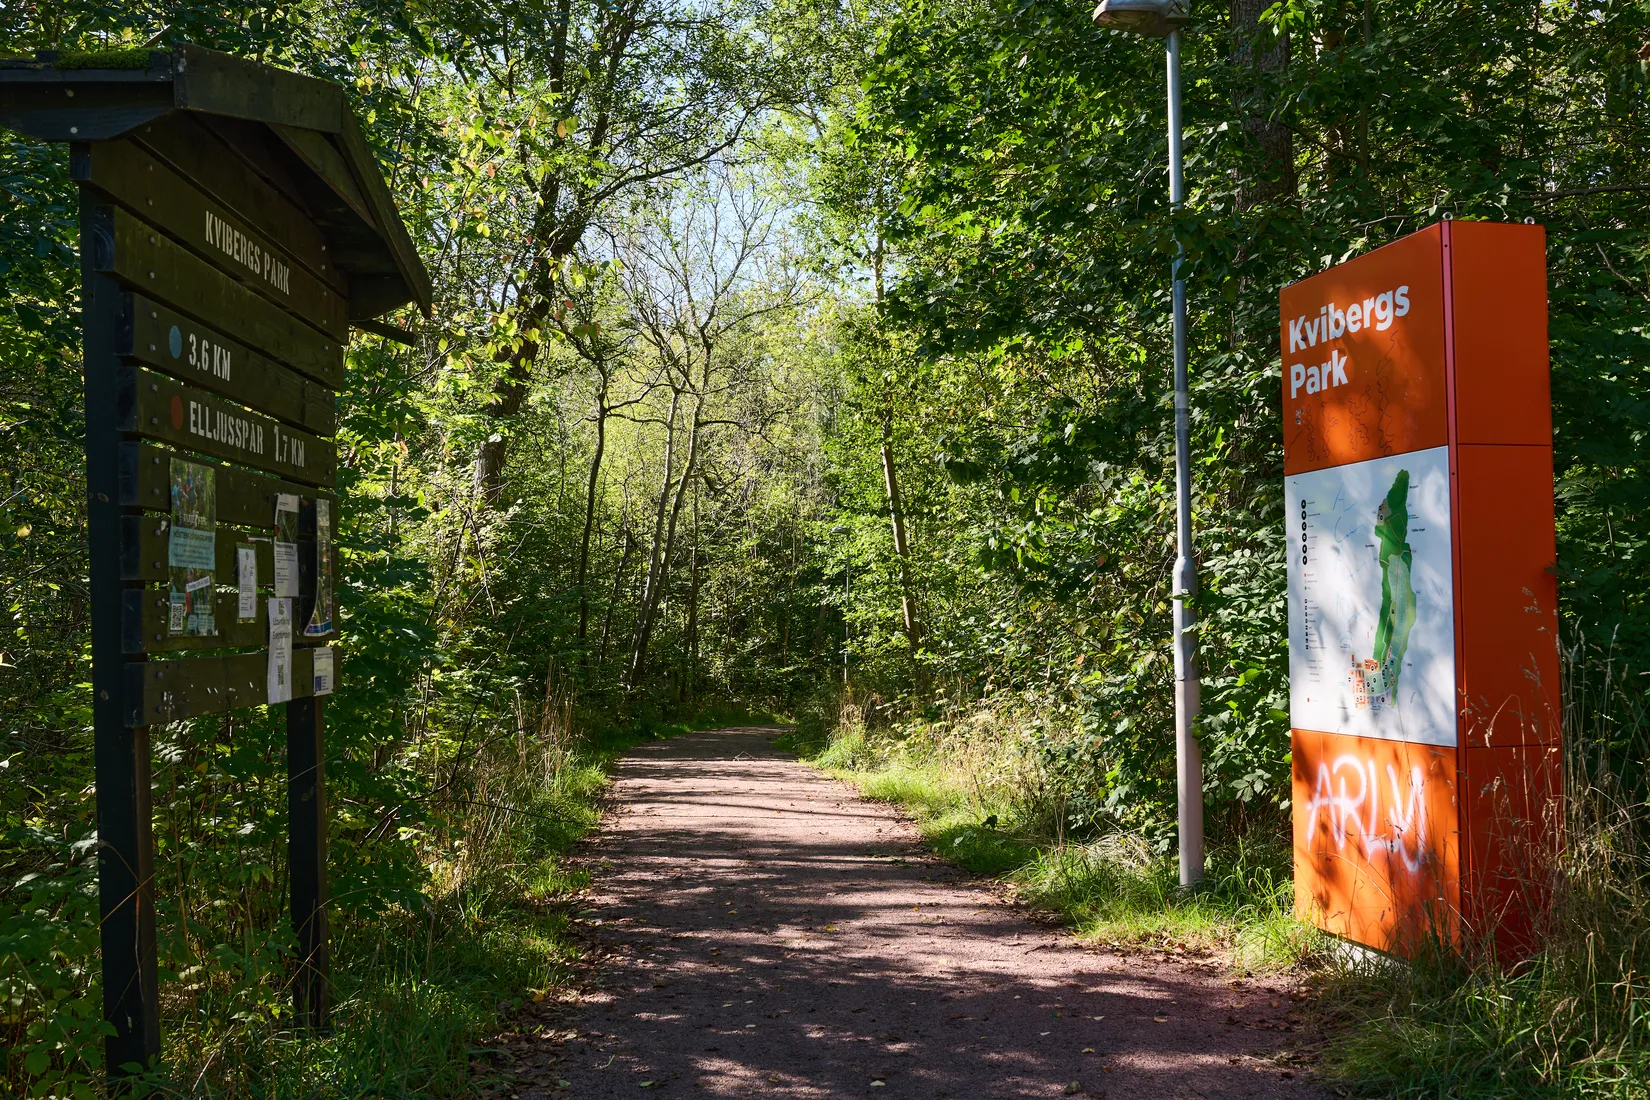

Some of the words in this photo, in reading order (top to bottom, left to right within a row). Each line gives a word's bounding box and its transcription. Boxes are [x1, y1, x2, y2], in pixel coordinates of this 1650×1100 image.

[205, 210, 260, 274] KVIBERGS
[264, 251, 290, 296] PARK
[1289, 285, 1410, 353] Kvibergs
[189, 333, 209, 370] 3,6
[213, 343, 231, 381] KM
[1290, 350, 1348, 399] Park
[190, 400, 263, 455] ELLJUSSPÅR
[291, 437, 304, 467] KM
